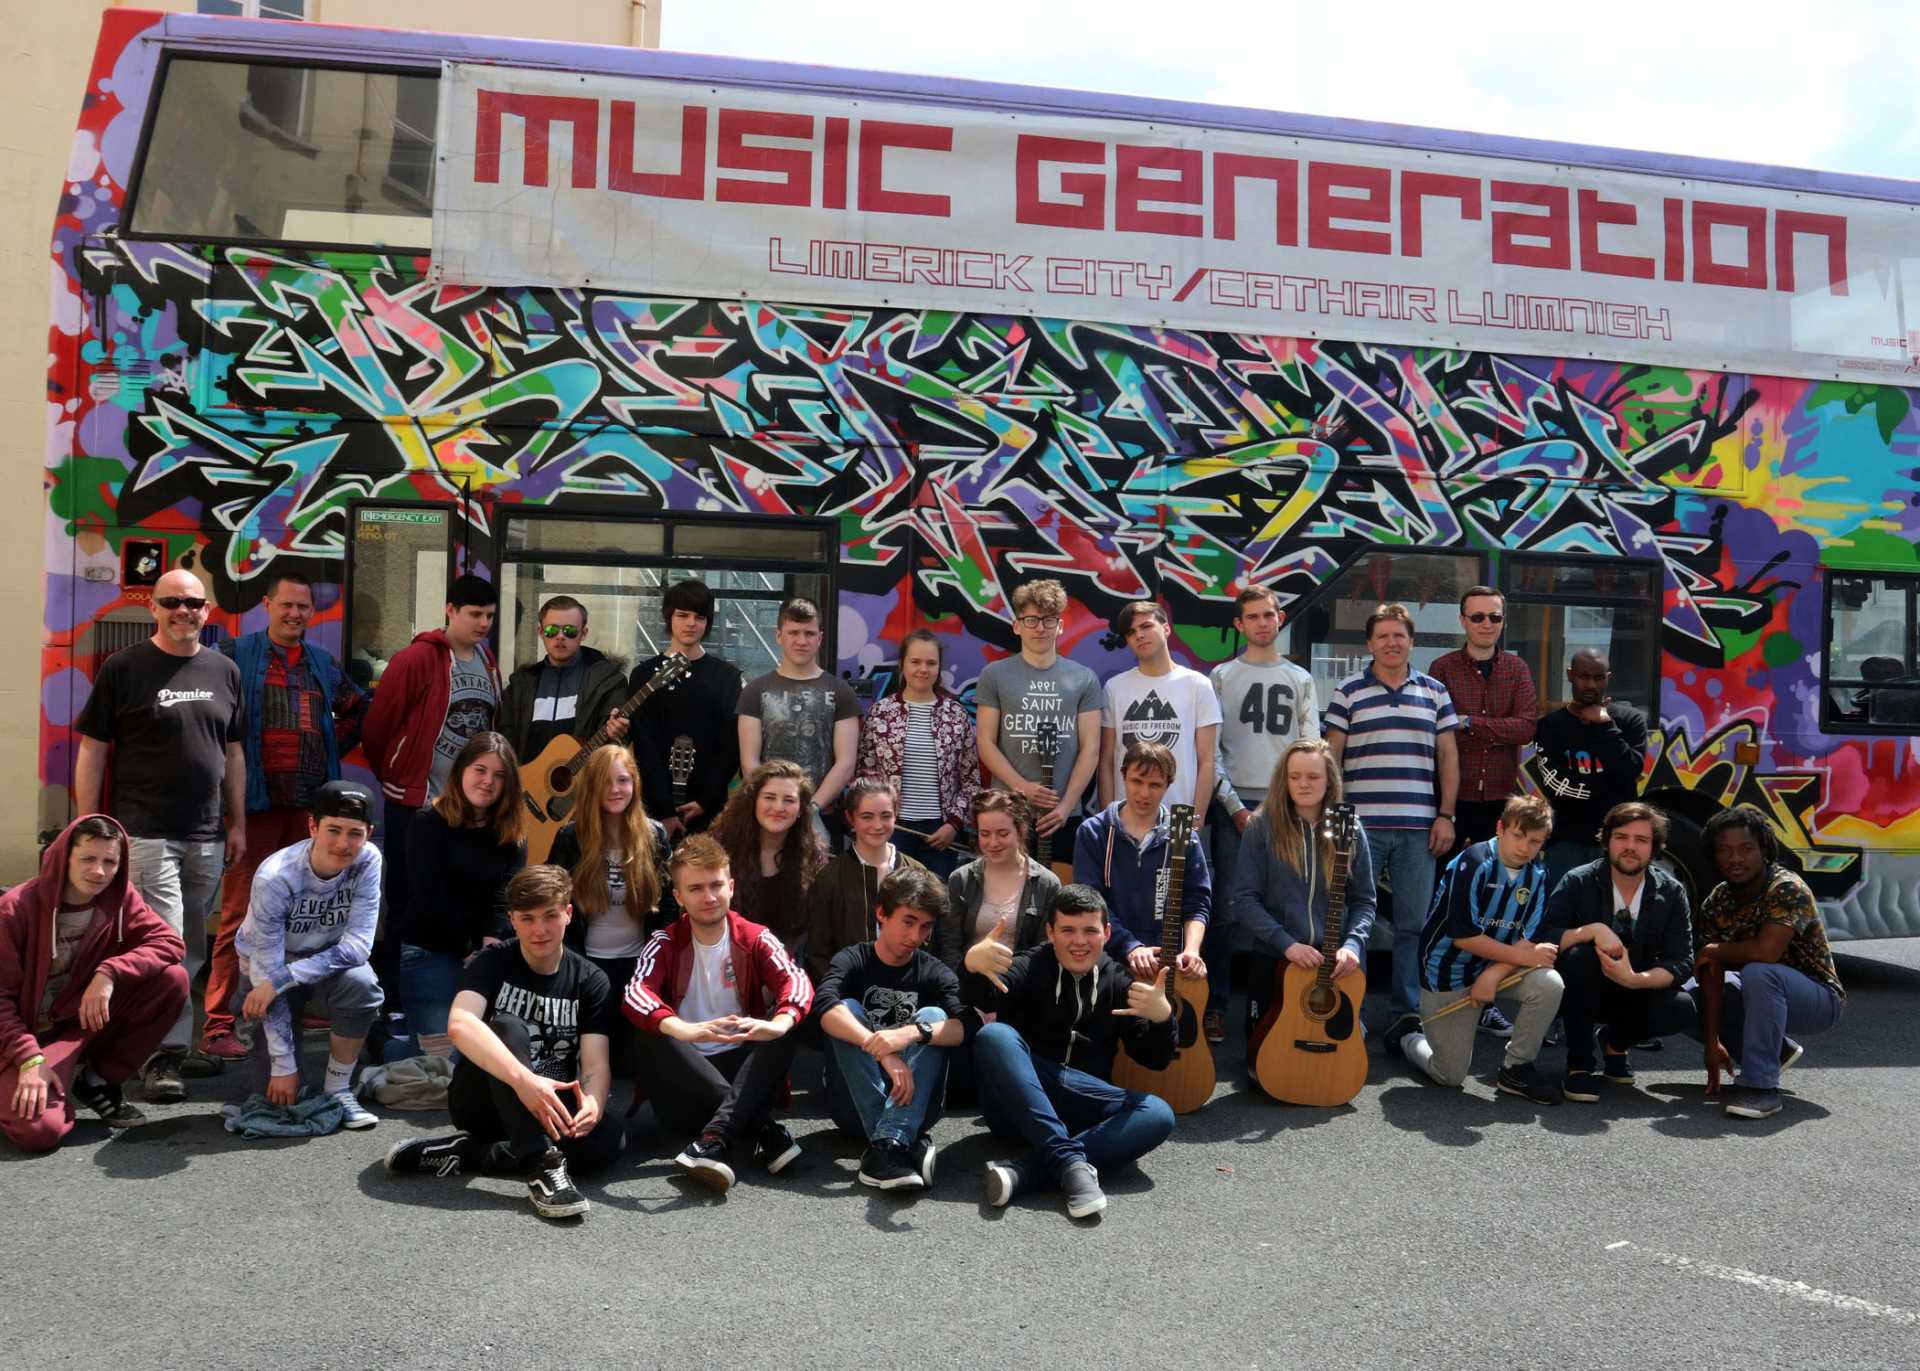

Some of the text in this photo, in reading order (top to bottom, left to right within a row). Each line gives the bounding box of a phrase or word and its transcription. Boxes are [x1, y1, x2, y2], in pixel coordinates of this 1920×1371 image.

[769, 237, 1034, 292] LIMERICK
[1448, 289, 1672, 341] LUIMNIGH
[372, 512, 441, 524] EMERGENCY EXIT
[157, 687, 215, 702] Premier
[1021, 697, 1064, 712] SAINT
[1239, 682, 1295, 736] 46
[1150, 722, 1182, 731] FREEDOM
